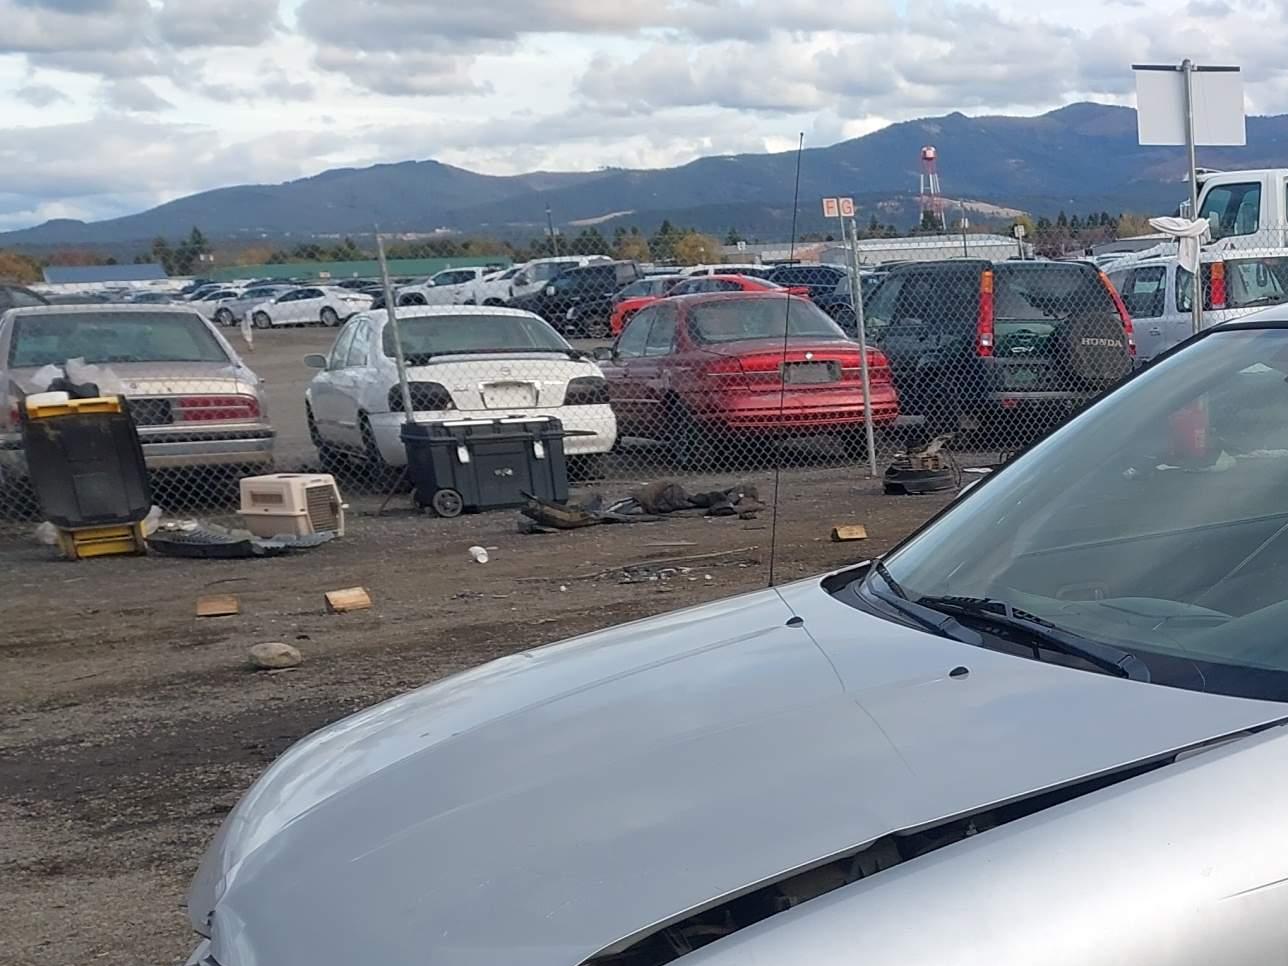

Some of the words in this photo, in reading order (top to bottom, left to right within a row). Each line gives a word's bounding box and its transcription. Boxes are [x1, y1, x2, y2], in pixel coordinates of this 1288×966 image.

[826, 200, 835, 215] F
[842, 199, 852, 215] G
[1081, 337, 1122, 348] HONDA
